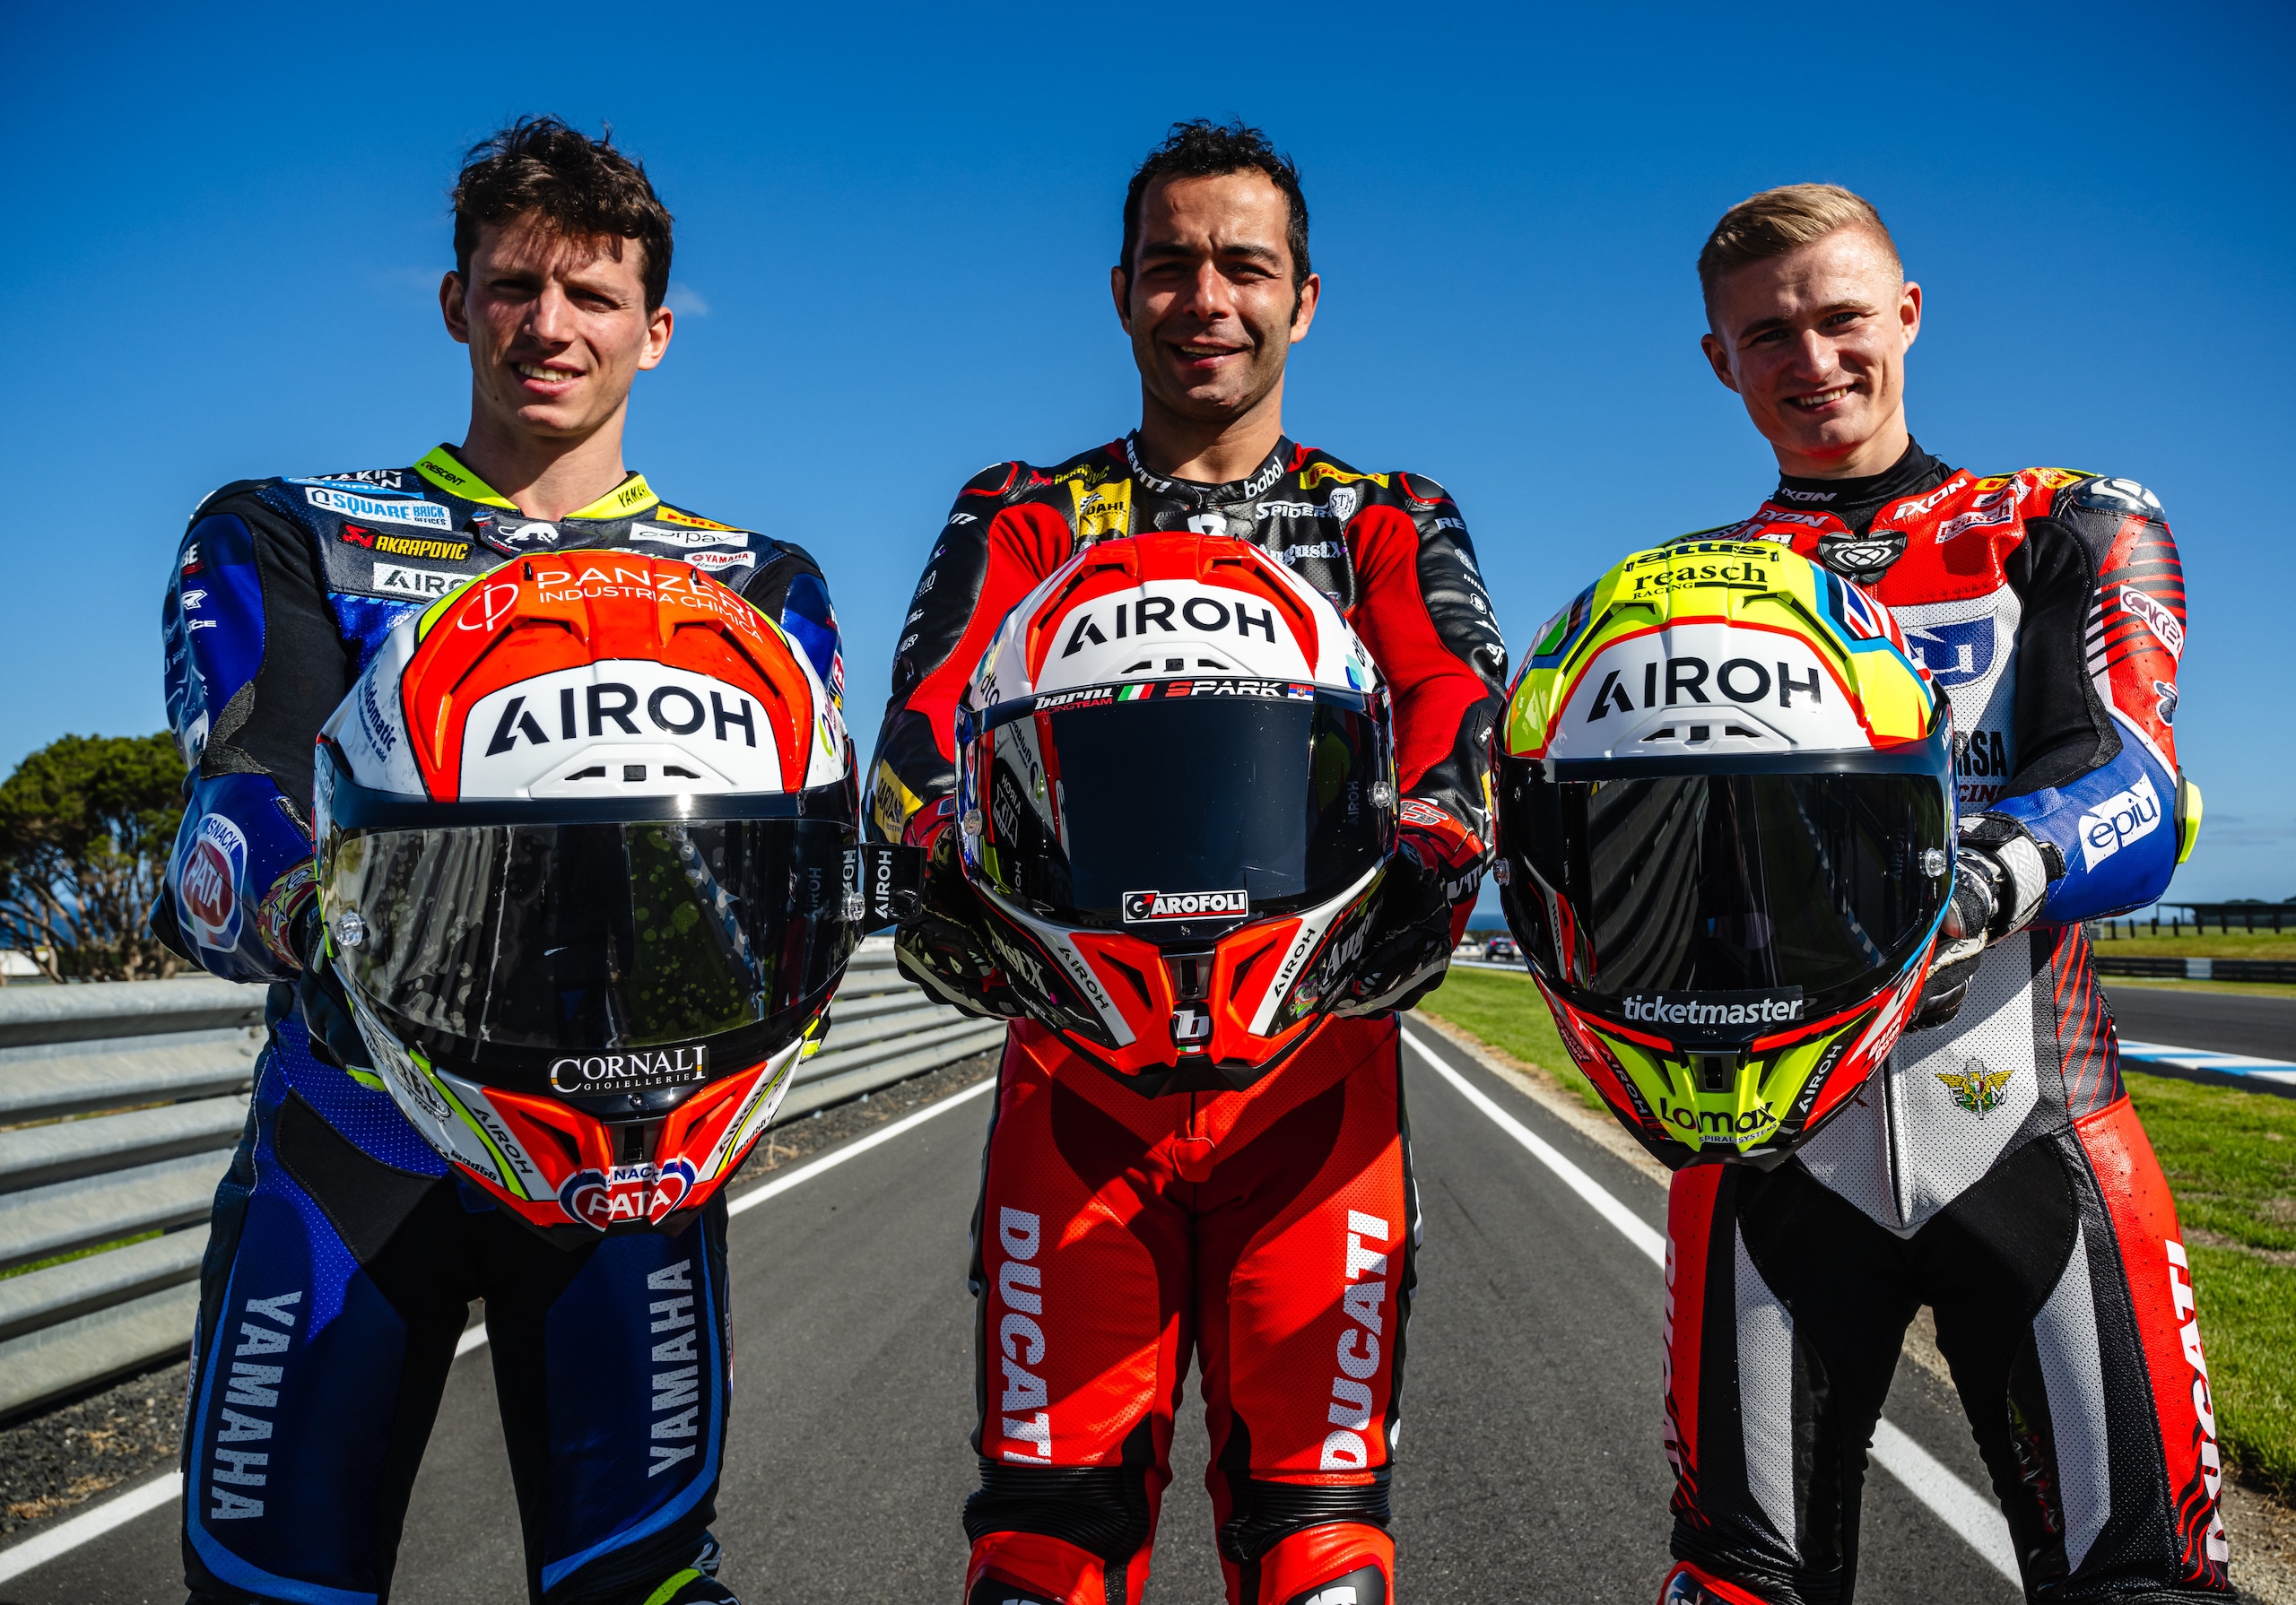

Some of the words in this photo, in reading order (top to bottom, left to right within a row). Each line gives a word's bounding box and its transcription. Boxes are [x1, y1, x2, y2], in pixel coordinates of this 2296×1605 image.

[420, 461, 466, 486] CRESCENT
[1243, 455, 1284, 499] babol
[333, 492, 411, 520] SQUARE
[413, 505, 446, 517] BRICK
[413, 517, 447, 526] OFFICES
[1331, 493, 1354, 512] STM
[705, 552, 749, 564] YAMAHA
[1633, 561, 1769, 592] reasch
[384, 569, 469, 594] AIRO
[1632, 581, 1694, 600] RACING
[540, 585, 674, 604] INDUSTRIA
[680, 595, 763, 643] CHIMICA
[1061, 595, 1276, 659] AIROH
[1034, 687, 1114, 711] barni
[1164, 681, 1283, 698] SPARK
[1586, 656, 1822, 724] AIROH
[484, 681, 757, 758] AIROH
[1959, 730, 2008, 776] RSA
[206, 818, 241, 855] SNACK
[185, 850, 222, 916] PATA
[874, 850, 892, 920] AIROH
[1126, 892, 1247, 918] GAROFOLI
[1057, 945, 1111, 1011] AIROH
[1274, 927, 1317, 999] AIROH
[1622, 994, 1804, 1024] ticketmaster
[550, 1044, 707, 1094] CORNALI
[583, 1072, 691, 1091] GIOIELLERIE
[1600, 1047, 1648, 1114] AIROH
[1798, 1044, 1843, 1114] AIROH
[472, 1106, 534, 1175] AIROH
[1699, 1134, 1733, 1143] SPIRAL
[1737, 1122, 1779, 1143] SYSTEMS
[587, 1191, 672, 1220] PATA
[997, 1205, 1053, 1466] DUCATI
[1318, 1209, 1390, 1471] DUCATI
[647, 1258, 699, 1479] YAMAHA
[211, 1289, 303, 1521] YAMAHA
